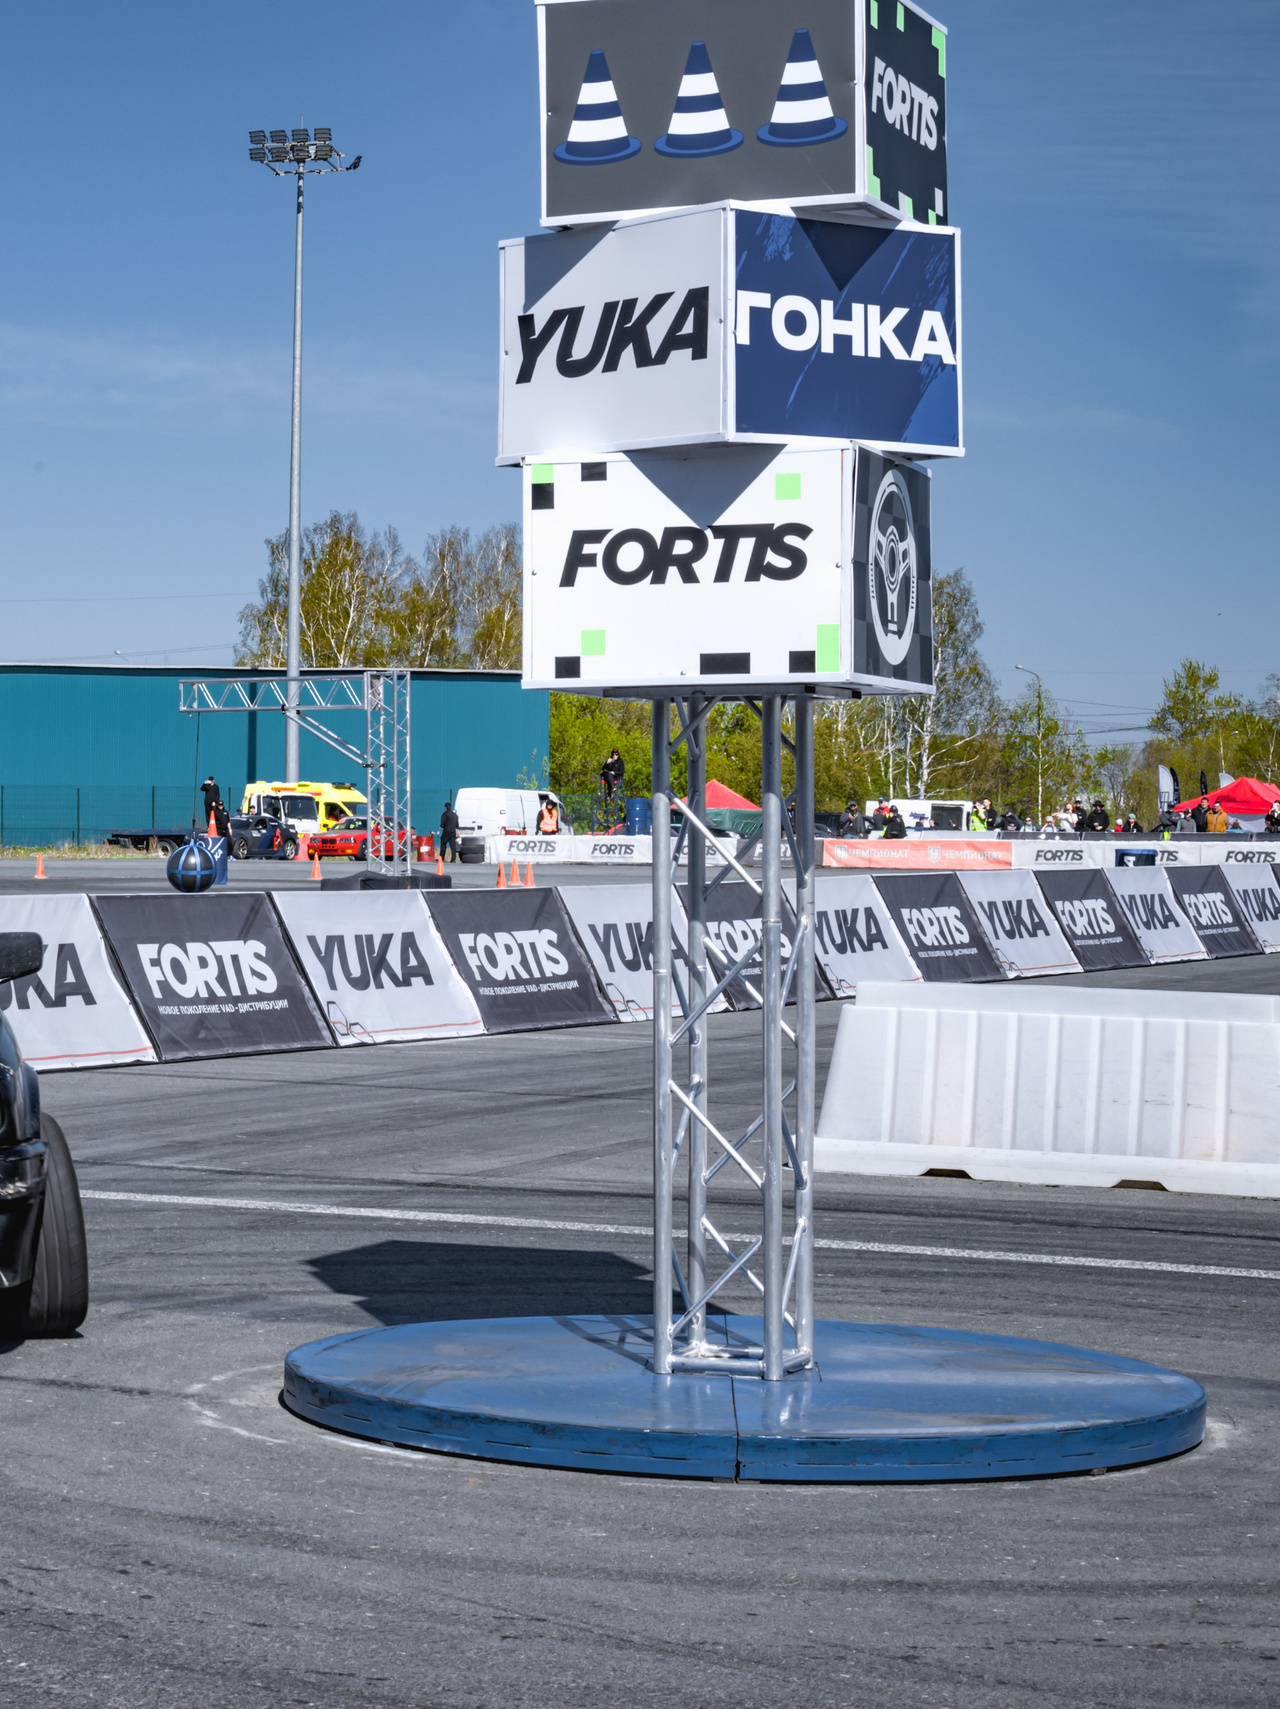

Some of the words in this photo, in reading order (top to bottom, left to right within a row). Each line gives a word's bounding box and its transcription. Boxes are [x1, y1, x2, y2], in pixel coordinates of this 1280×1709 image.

[872, 56, 938, 151] FORTIS
[515, 286, 709, 385] YUKA
[736, 289, 957, 365] ГОНКА
[559, 522, 813, 587] FORTIS
[507, 840, 556, 852] FORTIS
[591, 844, 635, 855] FORTIS
[849, 849, 910, 859] ЧЕМПИОНАТ
[943, 850, 1004, 861] ЧЕМПИОНАТ
[1035, 849, 1084, 862] FORTIS
[1225, 850, 1276, 863] FORTIS
[977, 899, 1050, 940] YUKA
[1055, 899, 1116, 936] FORTIS
[1120, 893, 1180, 930] YUKA
[1182, 892, 1233, 926] FORTIS
[1236, 887, 1280, 922] YUKA
[815, 907, 889, 954] YUKA
[900, 906, 970, 947] FORTIS
[137, 940, 277, 998] FORTIS
[307, 931, 434, 991] YUKA
[458, 929, 568, 981] FORTIS
[158, 1005, 180, 1014] НОВОЕ
[180, 1004, 221, 1014] ПОКОЛЕНИЕ
